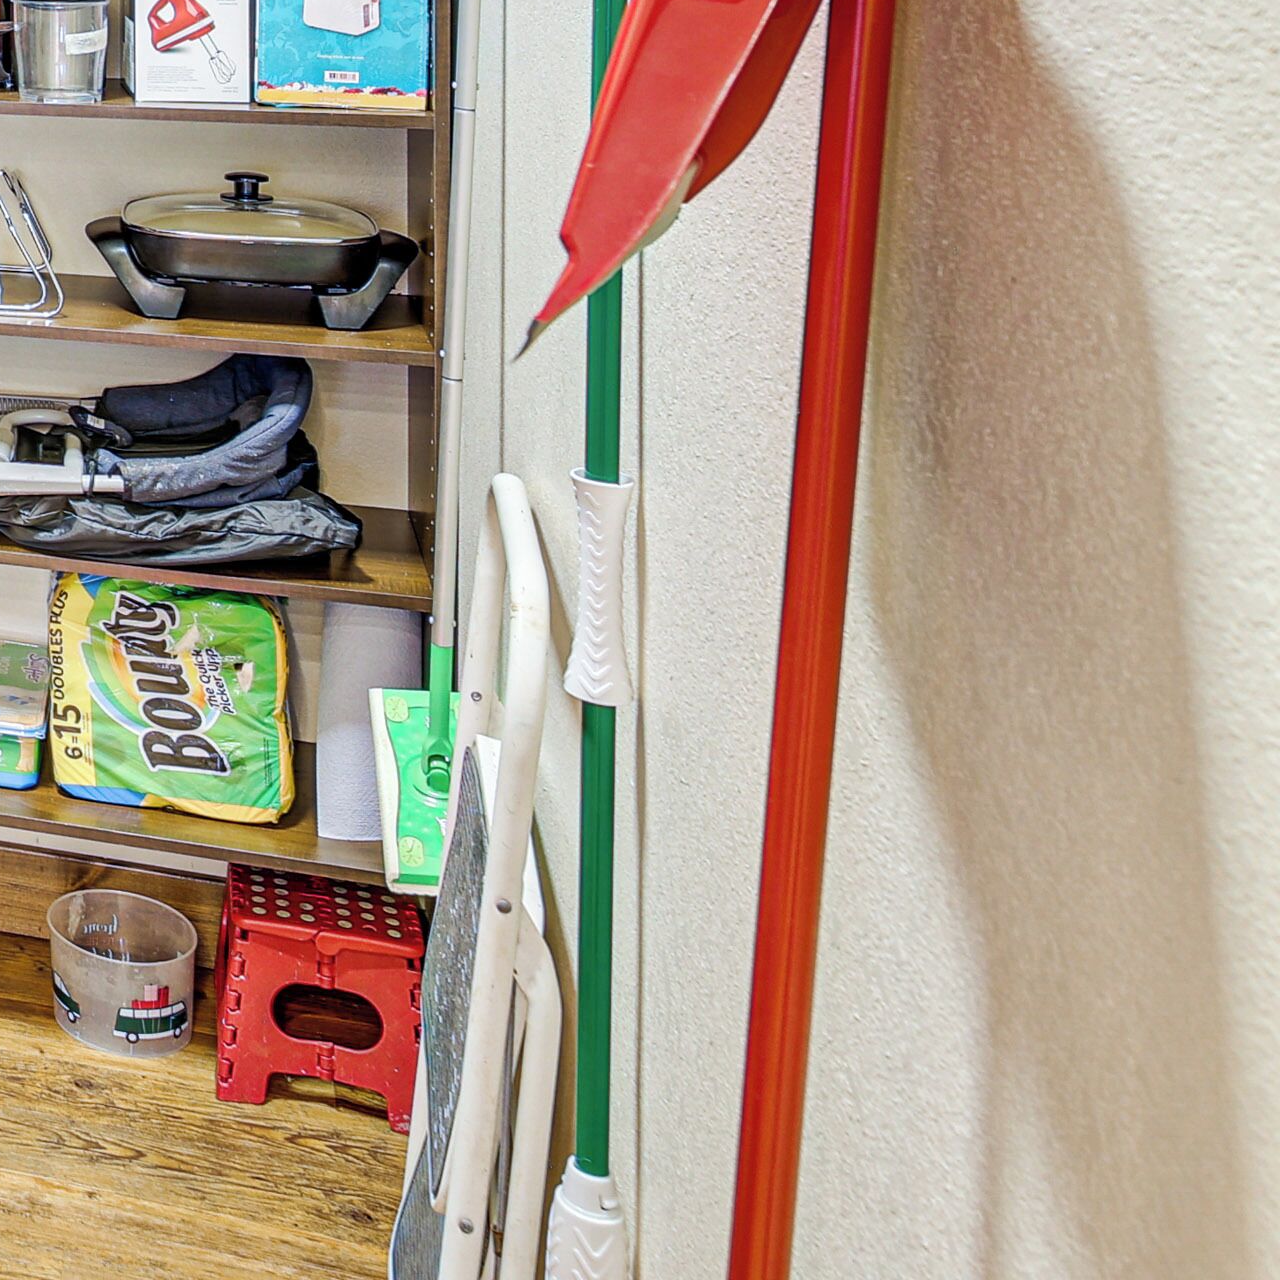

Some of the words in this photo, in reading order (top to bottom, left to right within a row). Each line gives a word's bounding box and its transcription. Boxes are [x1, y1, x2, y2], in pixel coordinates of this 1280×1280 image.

[49, 591, 69, 629] PLUS
[50, 630, 65, 701] DOUBLES
[191, 649, 210, 686] Quick
[205, 688, 220, 710] The
